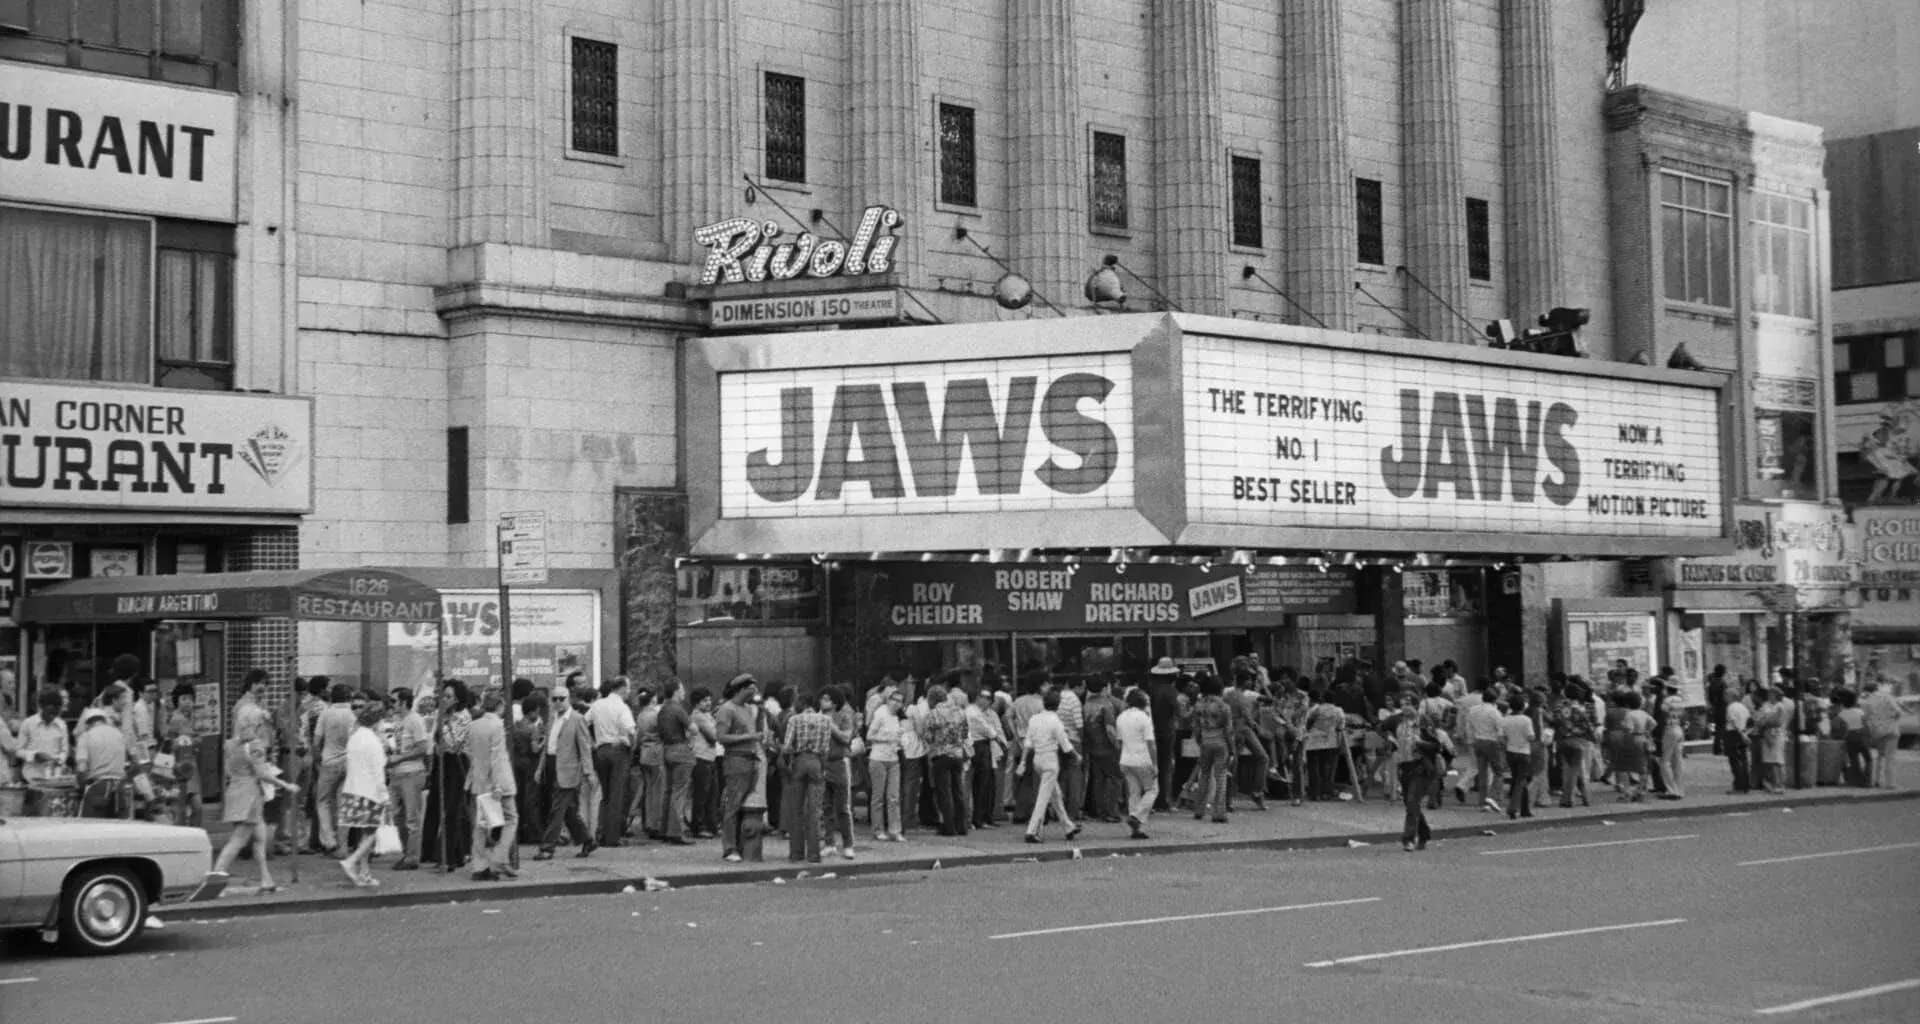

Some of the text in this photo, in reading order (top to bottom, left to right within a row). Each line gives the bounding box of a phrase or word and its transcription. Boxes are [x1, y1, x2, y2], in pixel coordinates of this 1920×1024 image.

[0, 102, 215, 182] URANT
[694, 204, 900, 285] Rivoli
[723, 301, 815, 322] DIMENSION
[821, 297, 850, 317] 150
[854, 298, 893, 310] THEATRE
[1208, 387, 1364, 423] THE TERRIFYING
[56, 400, 186, 436] CORNER
[746, 371, 1119, 503] JAWS
[1618, 422, 1663, 446] NOW A
[1276, 435, 1306, 460] NO.
[1380, 388, 1581, 506] JAWS
[0, 434, 234, 494] URANT
[1603, 458, 1686, 482] TERRIFYING
[1232, 475, 1357, 505] BEST SELLER
[1587, 494, 1707, 519] MOTION PICTURE
[349, 577, 389, 596] 1626
[995, 569, 1073, 590] ROBERT
[1090, 582, 1174, 601] RICHARD
[913, 582, 955, 603] ROY
[1008, 591, 1063, 611] SHAW
[1192, 582, 1238, 611] JAWS
[297, 595, 437, 620] RESTAURANT
[403, 602, 499, 636] WS
[891, 604, 983, 626] CHEIDER
[1085, 603, 1180, 623] DREYFUSS
